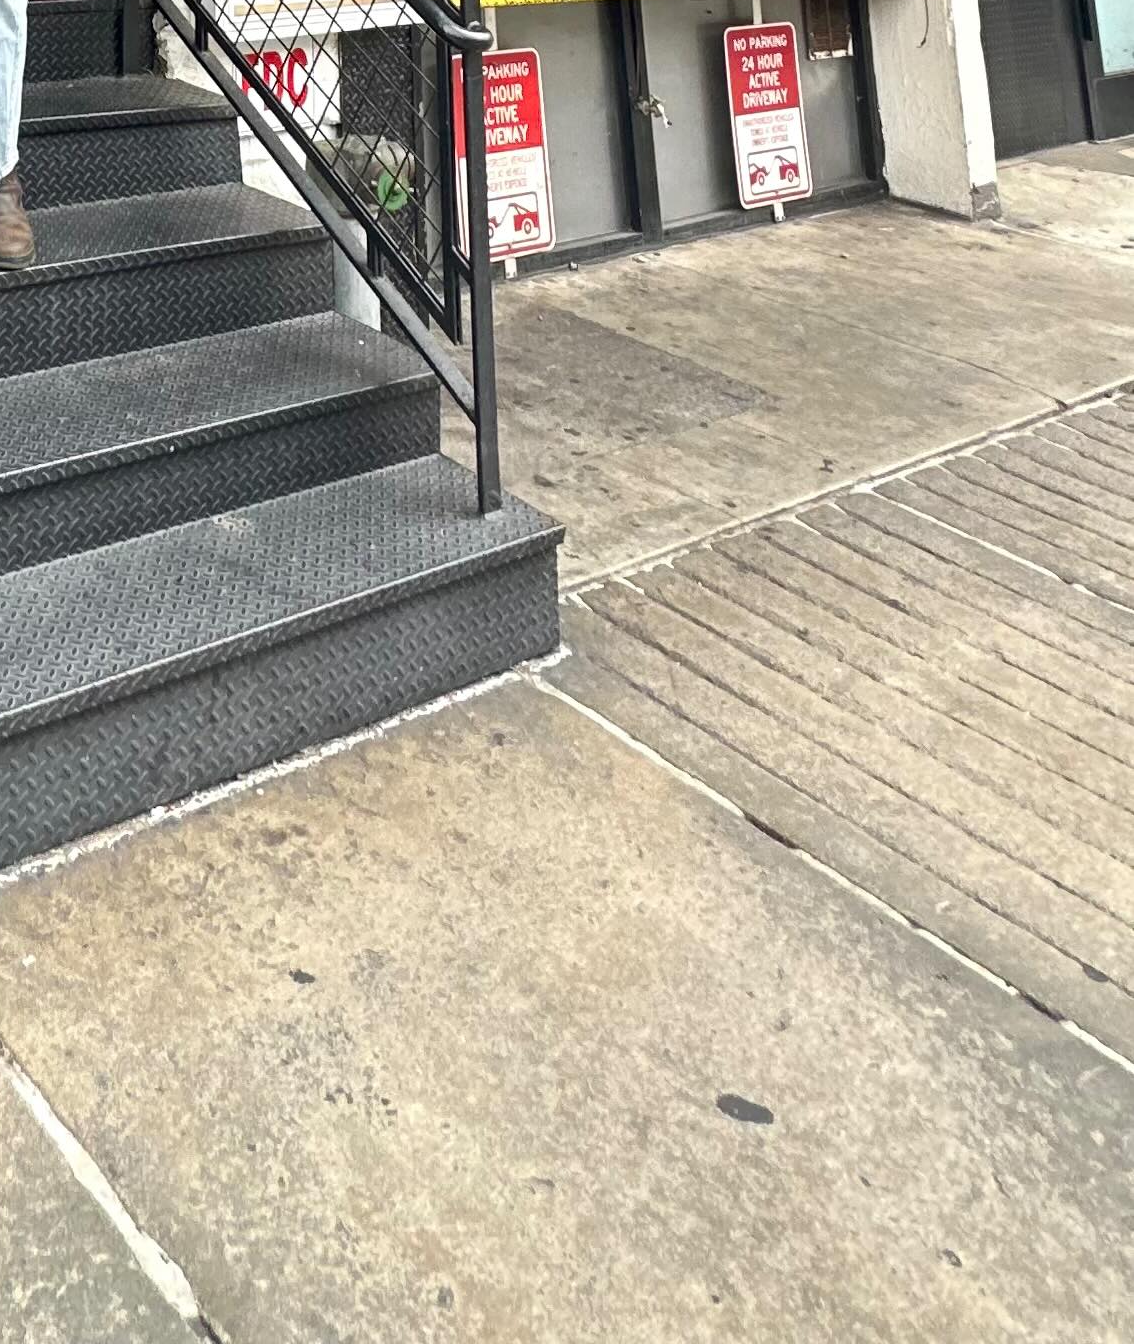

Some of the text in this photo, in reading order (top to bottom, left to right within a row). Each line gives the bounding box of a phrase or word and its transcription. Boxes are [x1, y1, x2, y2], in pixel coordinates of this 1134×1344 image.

[733, 33, 788, 52] NO PARKING
[741, 52, 784, 72] 24 HOUR
[749, 70, 781, 90] ACTIVE
[490, 83, 523, 104] HOUR
[742, 87, 789, 109] DRIVEWAY
[486, 123, 529, 147] IVEWAY
